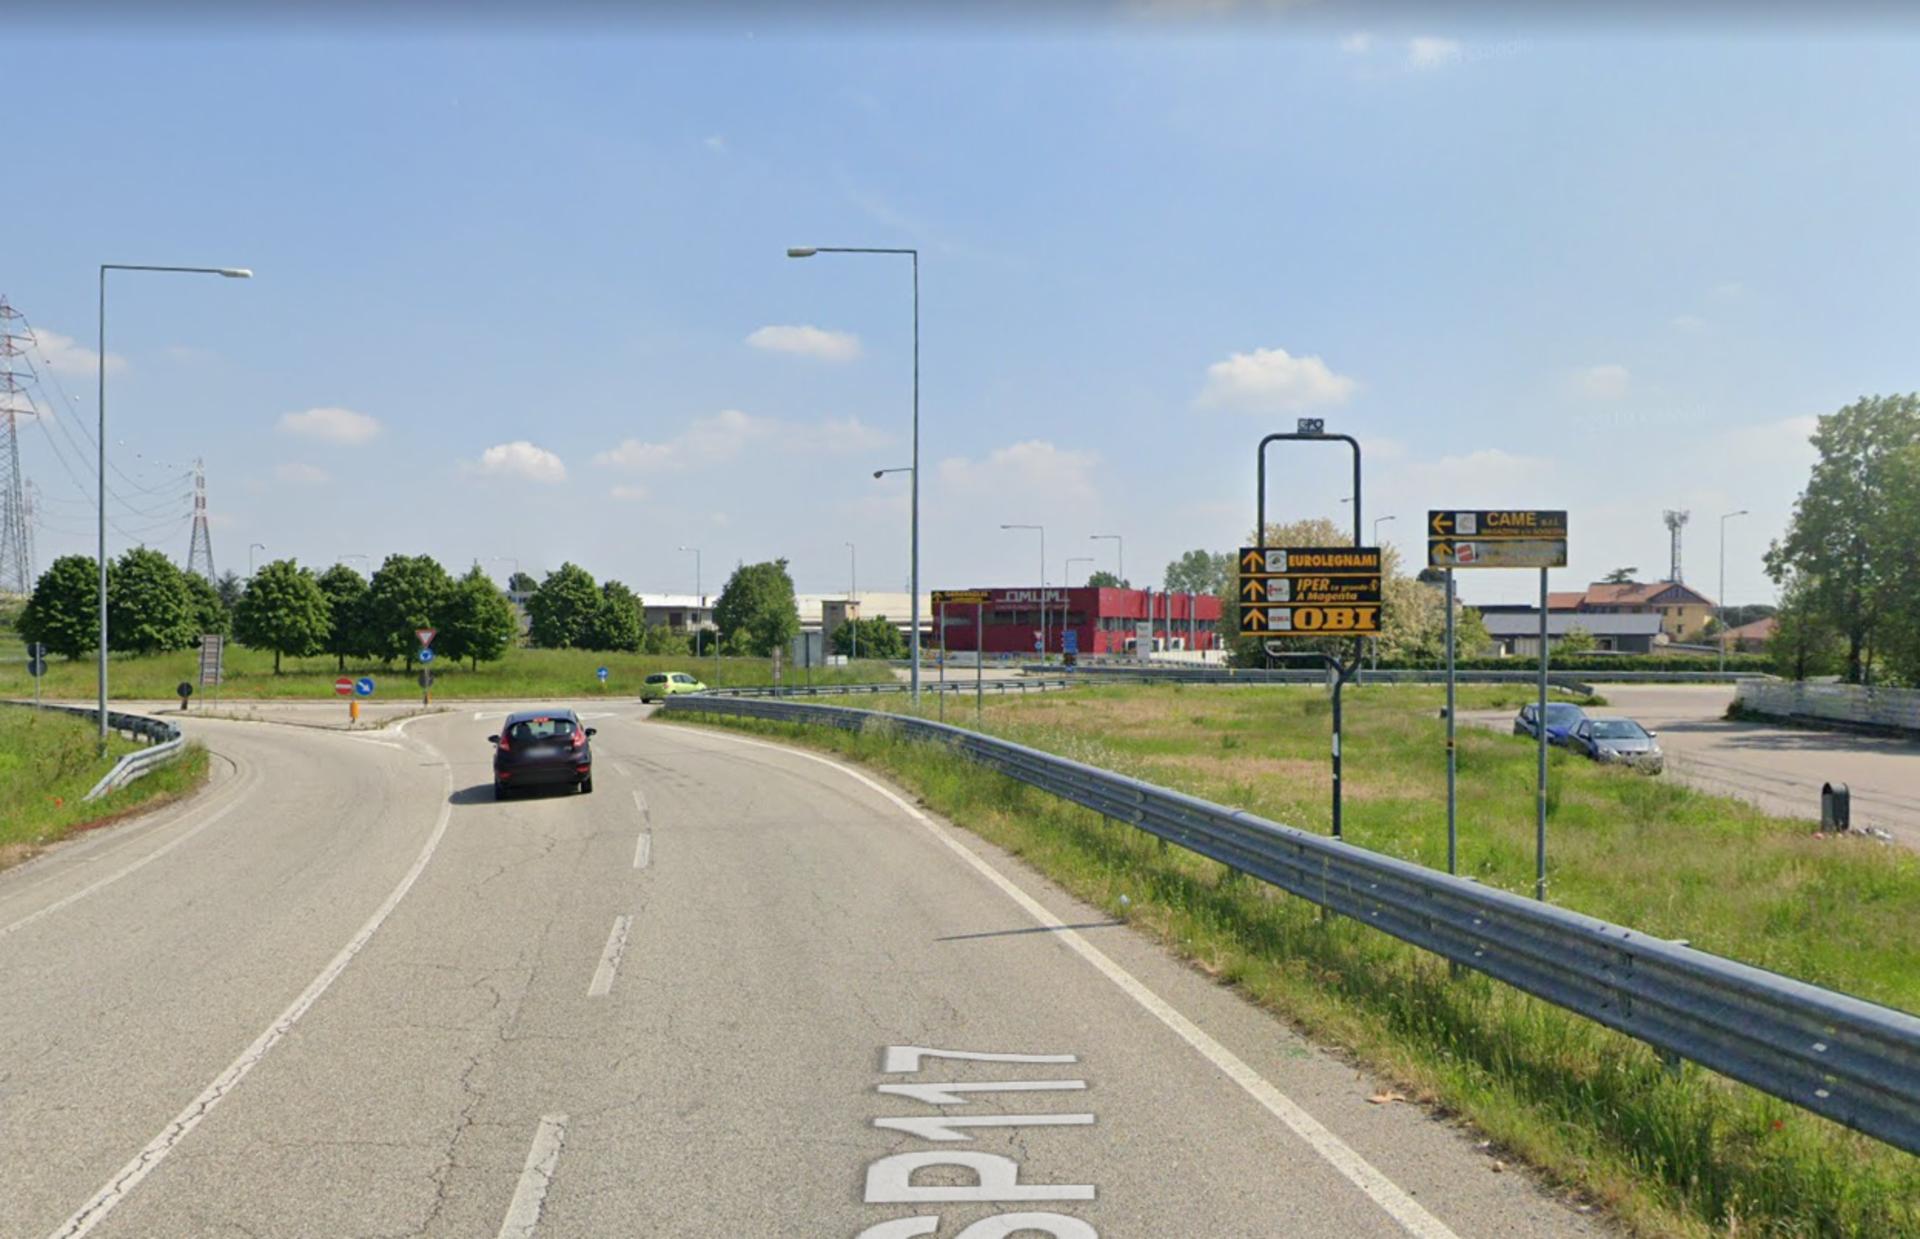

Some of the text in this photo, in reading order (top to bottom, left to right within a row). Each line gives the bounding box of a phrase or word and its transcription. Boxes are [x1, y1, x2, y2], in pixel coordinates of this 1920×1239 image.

[1486, 512, 1537, 527] CAME
[1288, 554, 1377, 567] EUROLEGNAMI
[1296, 578, 1330, 591] IPER
[1295, 592, 1358, 603] A Magenta
[1293, 607, 1377, 630] OBI
